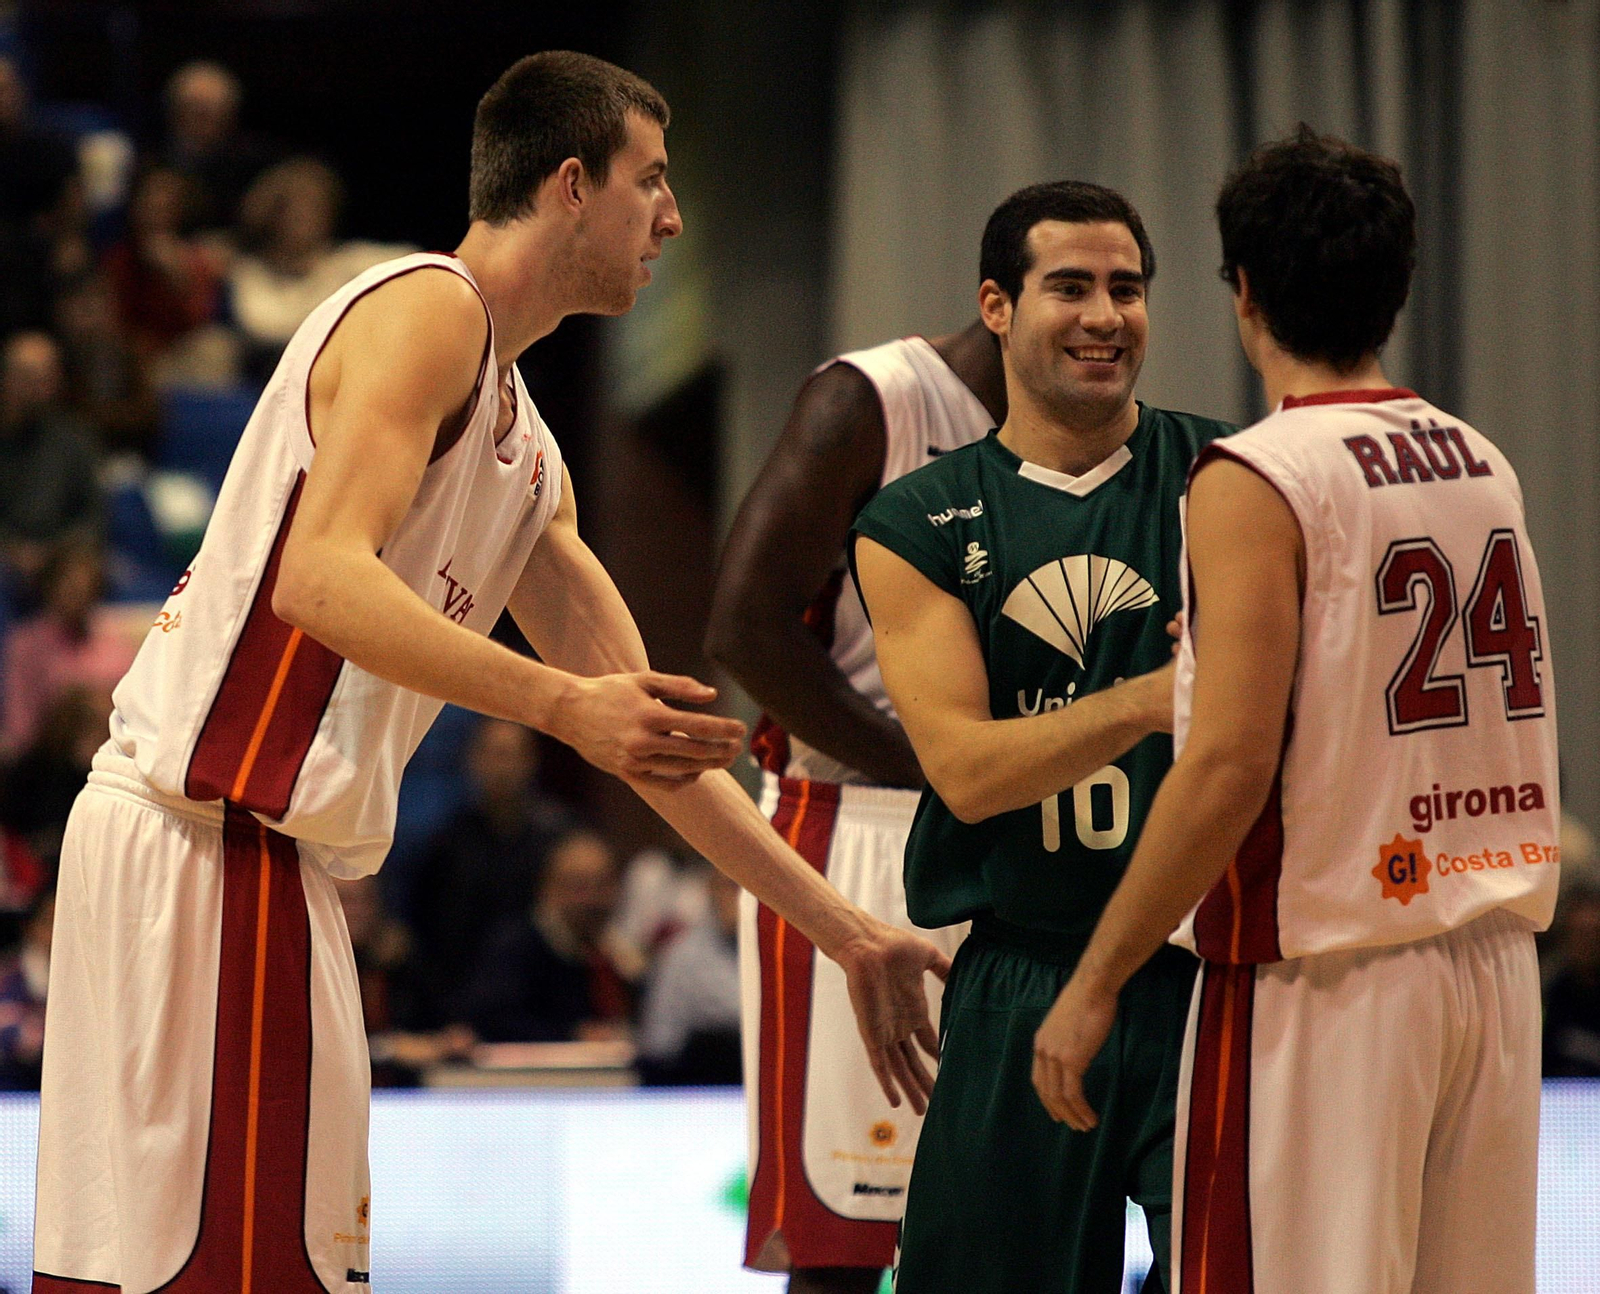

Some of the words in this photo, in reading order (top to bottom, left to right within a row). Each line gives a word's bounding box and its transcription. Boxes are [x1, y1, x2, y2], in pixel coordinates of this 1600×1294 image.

[1375, 528, 1545, 735] 24
[1041, 765, 1130, 853] 10
[1409, 783, 1545, 833] girona
[1388, 853, 1418, 884] G!
[1436, 848, 1514, 877] Costa
